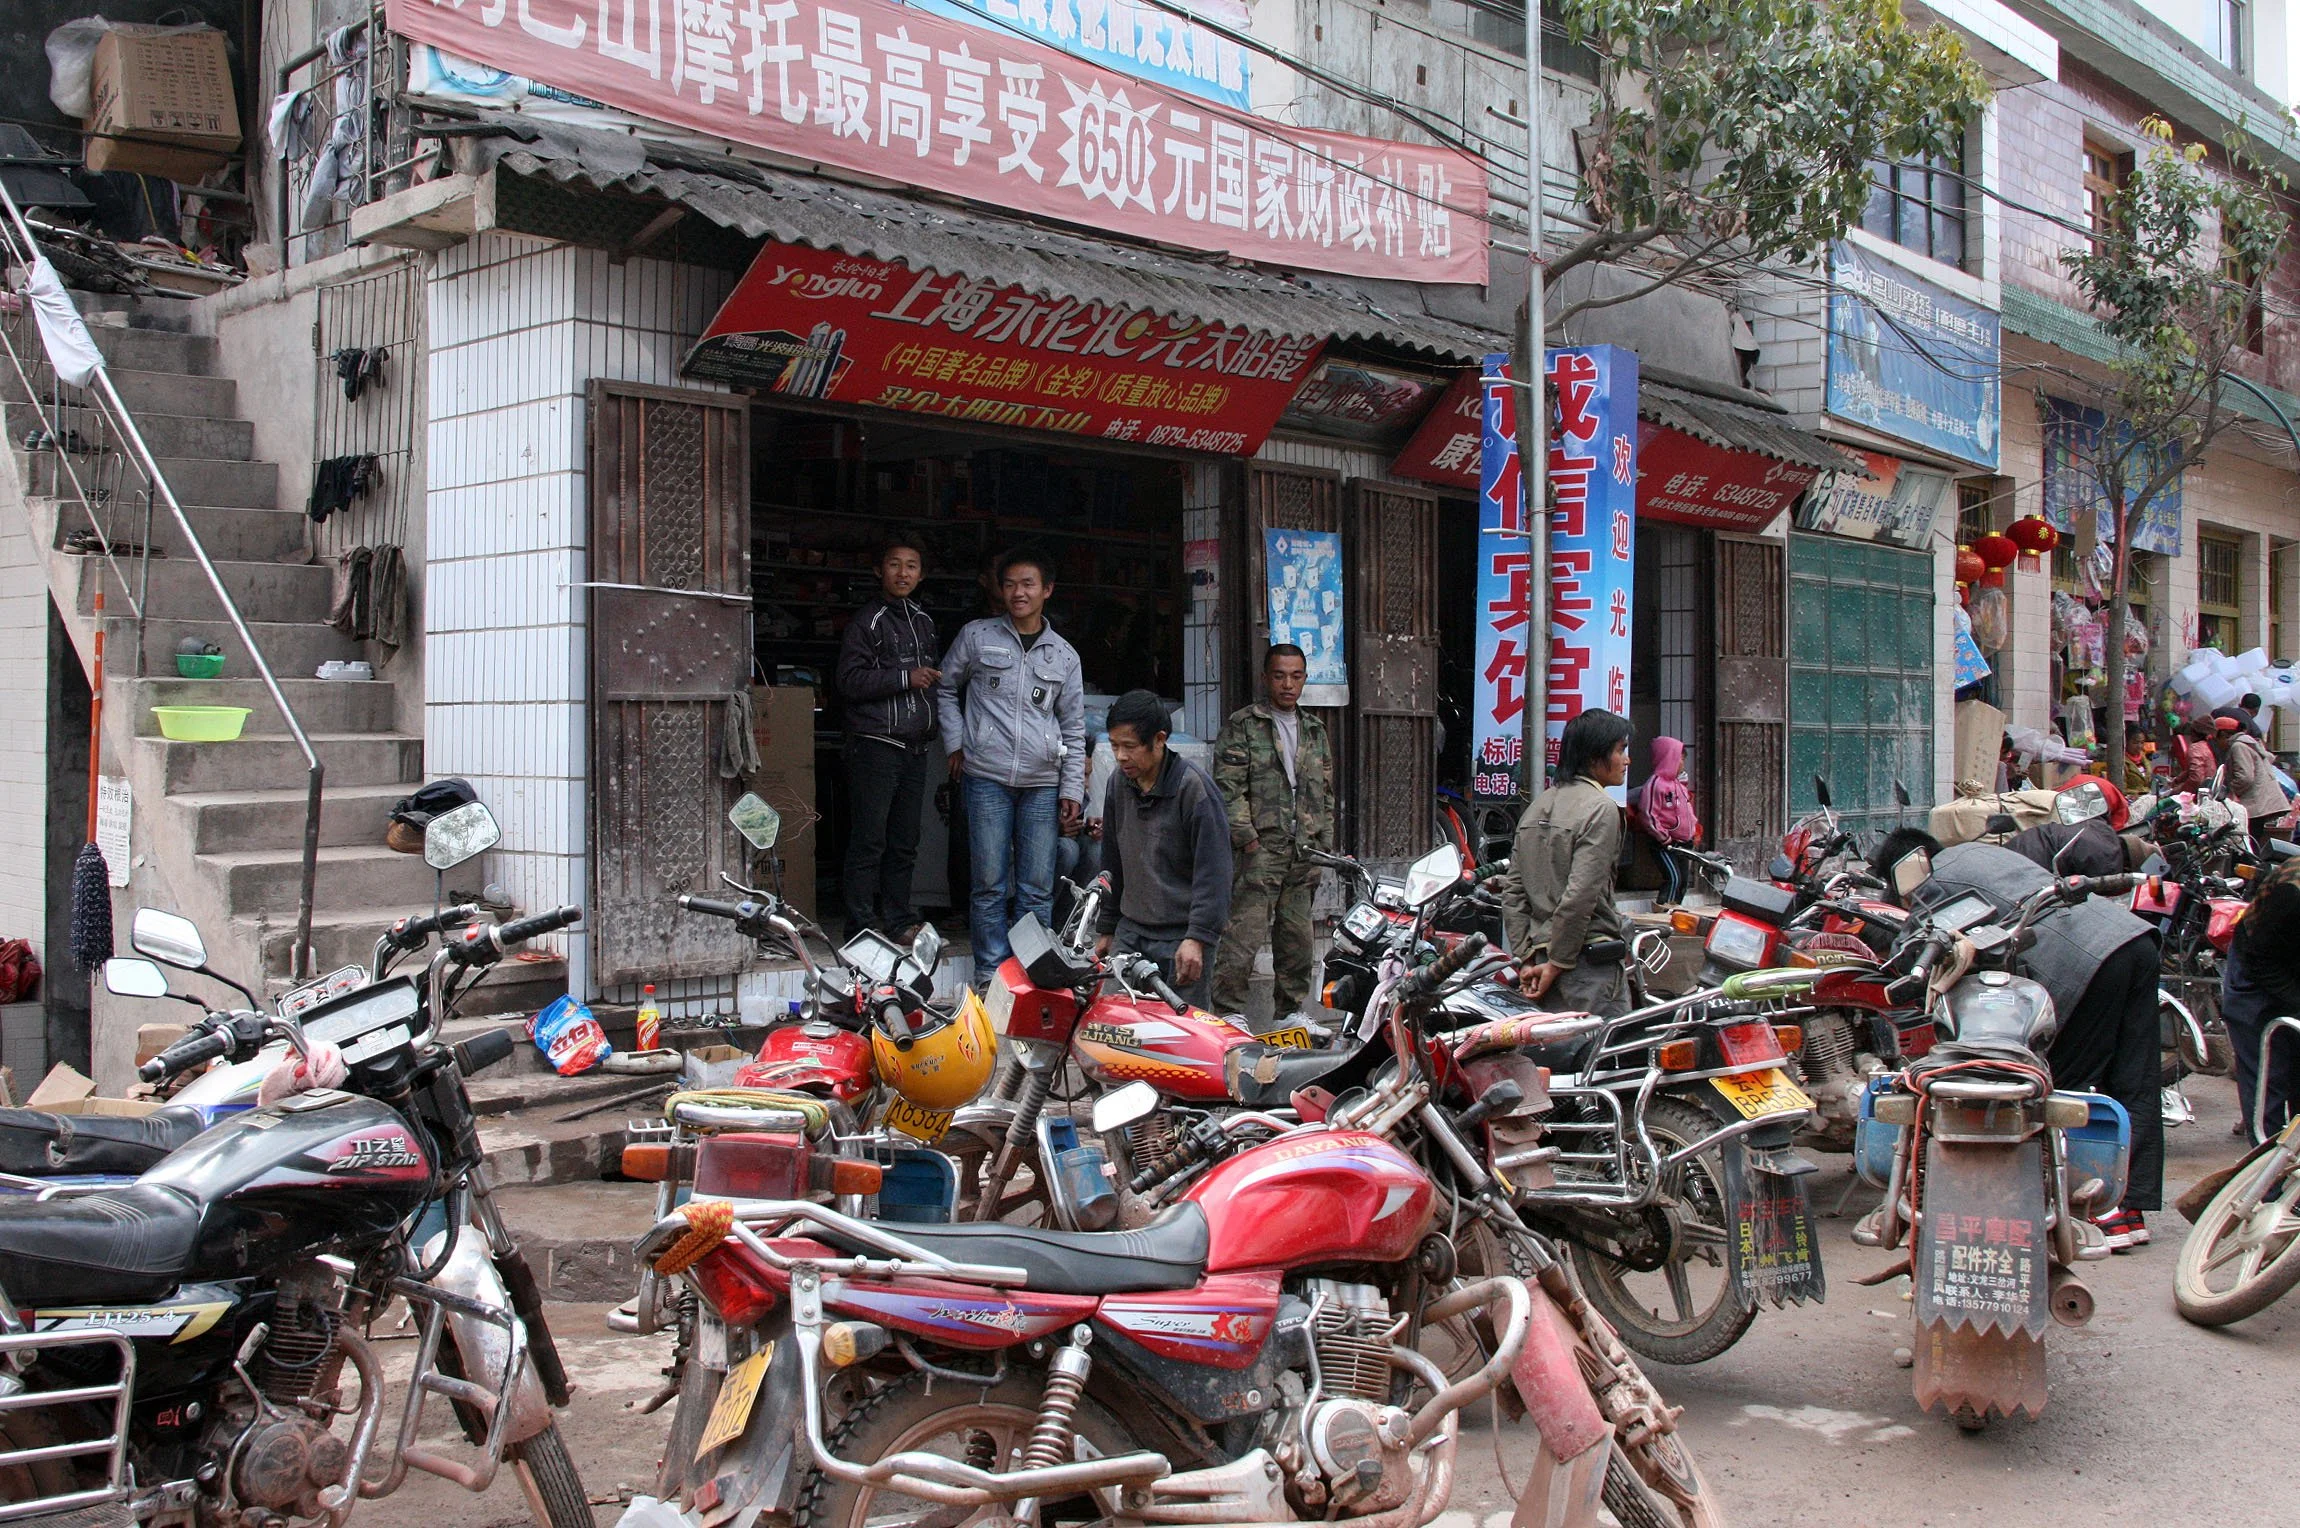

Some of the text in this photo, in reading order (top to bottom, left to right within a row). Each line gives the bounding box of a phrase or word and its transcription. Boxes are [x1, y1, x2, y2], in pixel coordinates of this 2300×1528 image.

[428, 0, 1452, 258] 山摩托最高享受650元国家财政补贴
[1147, 424, 1247, 453] 0879-6348725
[1712, 482, 1783, 510] 6348725
[1484, 352, 1600, 727] 诚信宾馆
[1607, 433, 1634, 714] 欢迎光临
[374, 1152, 420, 1168] STAR
[1274, 1135, 1380, 1161] DAYANG
[1951, 1244, 2014, 1275] 配件齐全
[2019, 1247, 2032, 1304] 一路平安
[86, 1309, 177, 1327] LJ125-4
